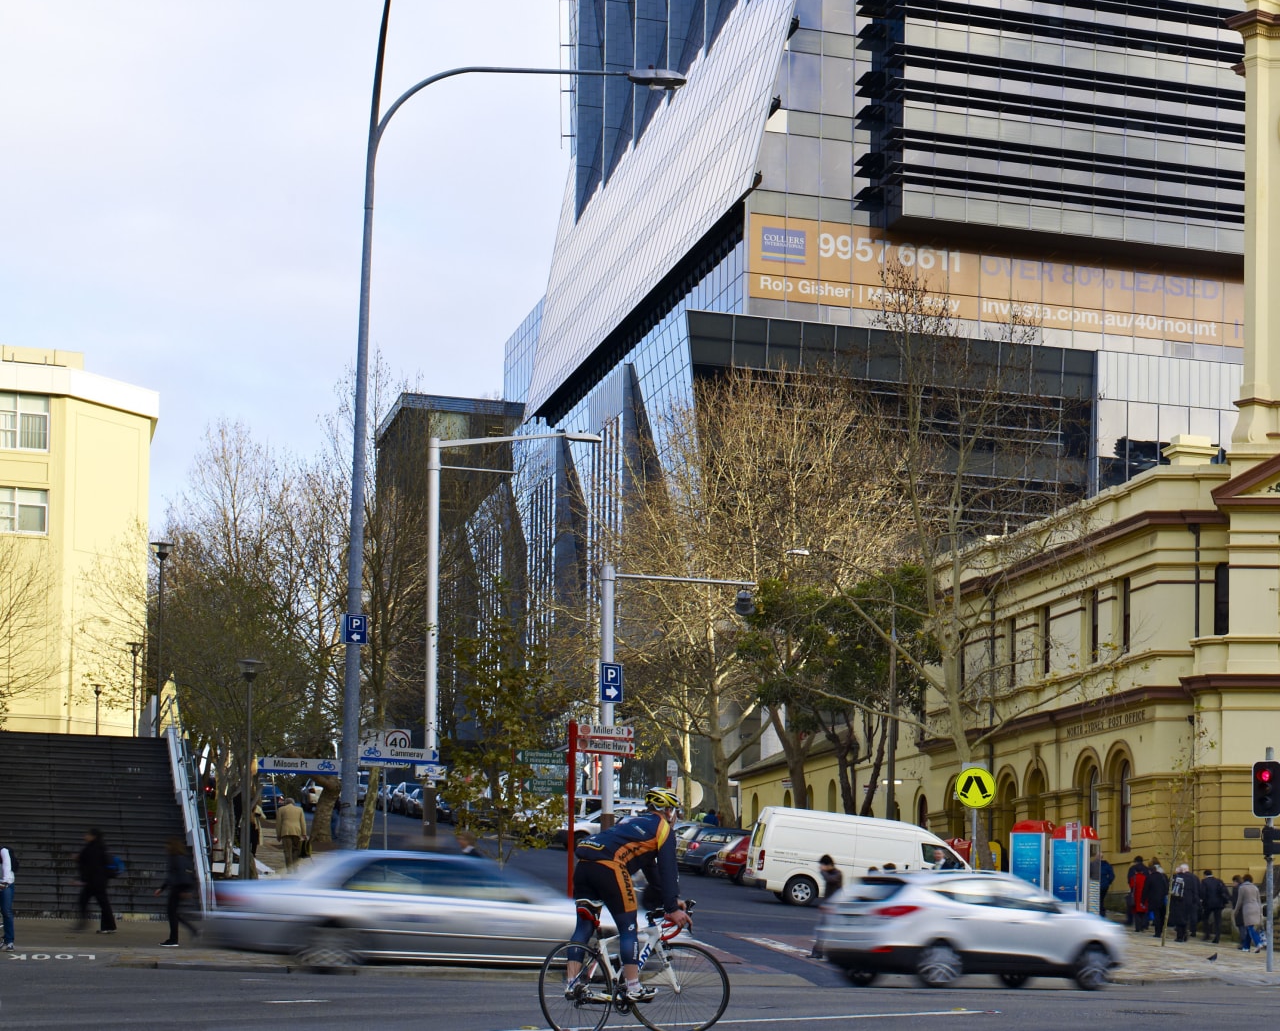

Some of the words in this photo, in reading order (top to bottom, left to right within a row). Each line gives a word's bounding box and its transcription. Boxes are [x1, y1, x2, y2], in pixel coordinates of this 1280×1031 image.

[763, 233, 805, 245] COLLIERS
[819, 232, 891, 264] 9957
[898, 243, 961, 273] 6611
[980, 255, 1055, 283] OVER
[1119, 269, 1220, 301] LEASED
[759, 276, 794, 293] Rob
[796, 280, 854, 300] Gishen
[982, 298, 1217, 338] investa.com.au/40mount
[352, 618, 361, 629] P
[607, 668, 617, 682] P
[1108, 714, 1123, 729] POST
[1124, 709, 1146, 724] OFFICE
[593, 726, 614, 735] Miller
[616, 727, 625, 736] St
[389, 737, 408, 749] 40
[589, 740, 611, 749] Pacific
[612, 741, 628, 753] Hwy
[390, 748, 424, 759] Cammeray
[273, 758, 299, 768] Milsons
[300, 759, 309, 769] Pt
